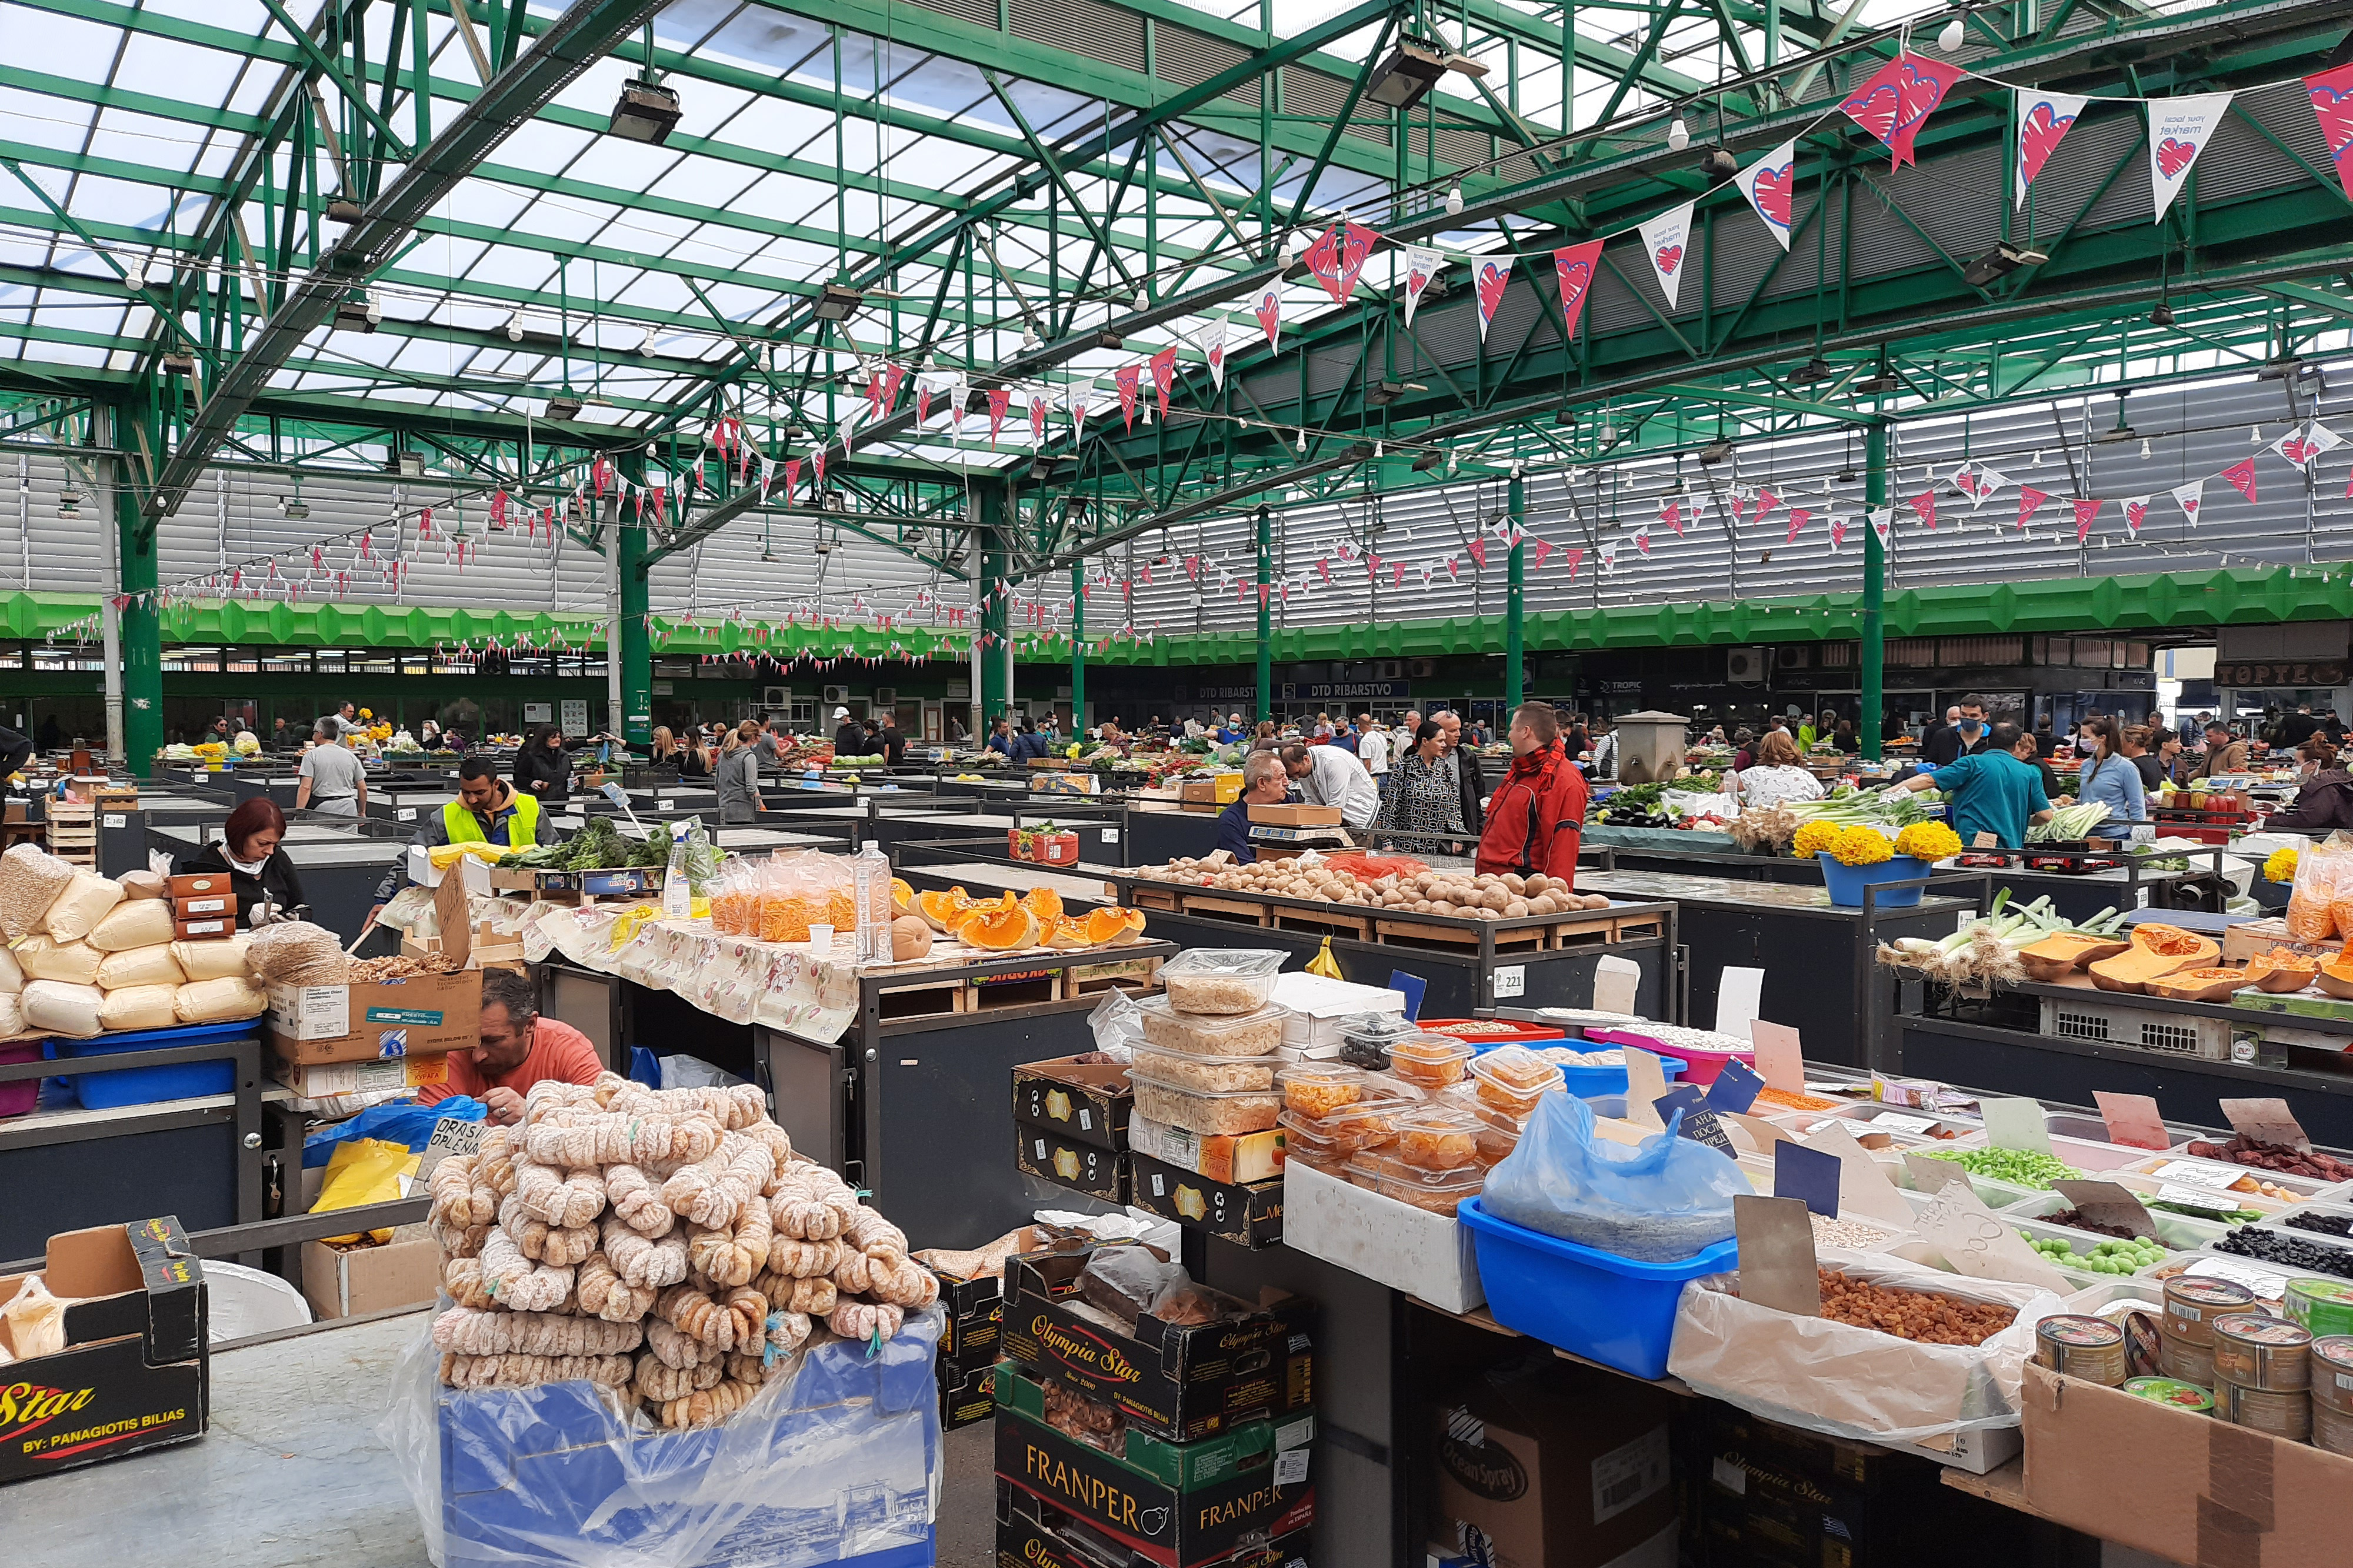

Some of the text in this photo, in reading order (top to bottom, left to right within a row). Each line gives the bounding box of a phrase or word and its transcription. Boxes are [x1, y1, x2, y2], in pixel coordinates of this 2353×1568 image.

[1200, 688, 1216, 698] DTD
[1311, 684, 1392, 696] DTD RIBARSTVO
[1507, 976, 1521, 987] 221
[430, 1133, 479, 1155] OPLENA
[1205, 1161, 1225, 1175] КУРАГА
[1219, 1322, 1288, 1349] Olympia Star
[1031, 1315, 1097, 1363] Olympia
[1100, 1348, 1142, 1383] Star
[1080, 1377, 1096, 1391] 2000
[0, 1382, 95, 1427] Star
[1122, 1395, 1153, 1416] PANAGIOTIS
[1154, 1411, 1170, 1424] BILIAS
[22, 1407, 185, 1454] BY: PANAGIOTIS BILIAS
[1026, 1443, 1140, 1532] FRANPER
[1794, 1480, 1832, 1504] Star
[1200, 1484, 1283, 1529] FRANPER
